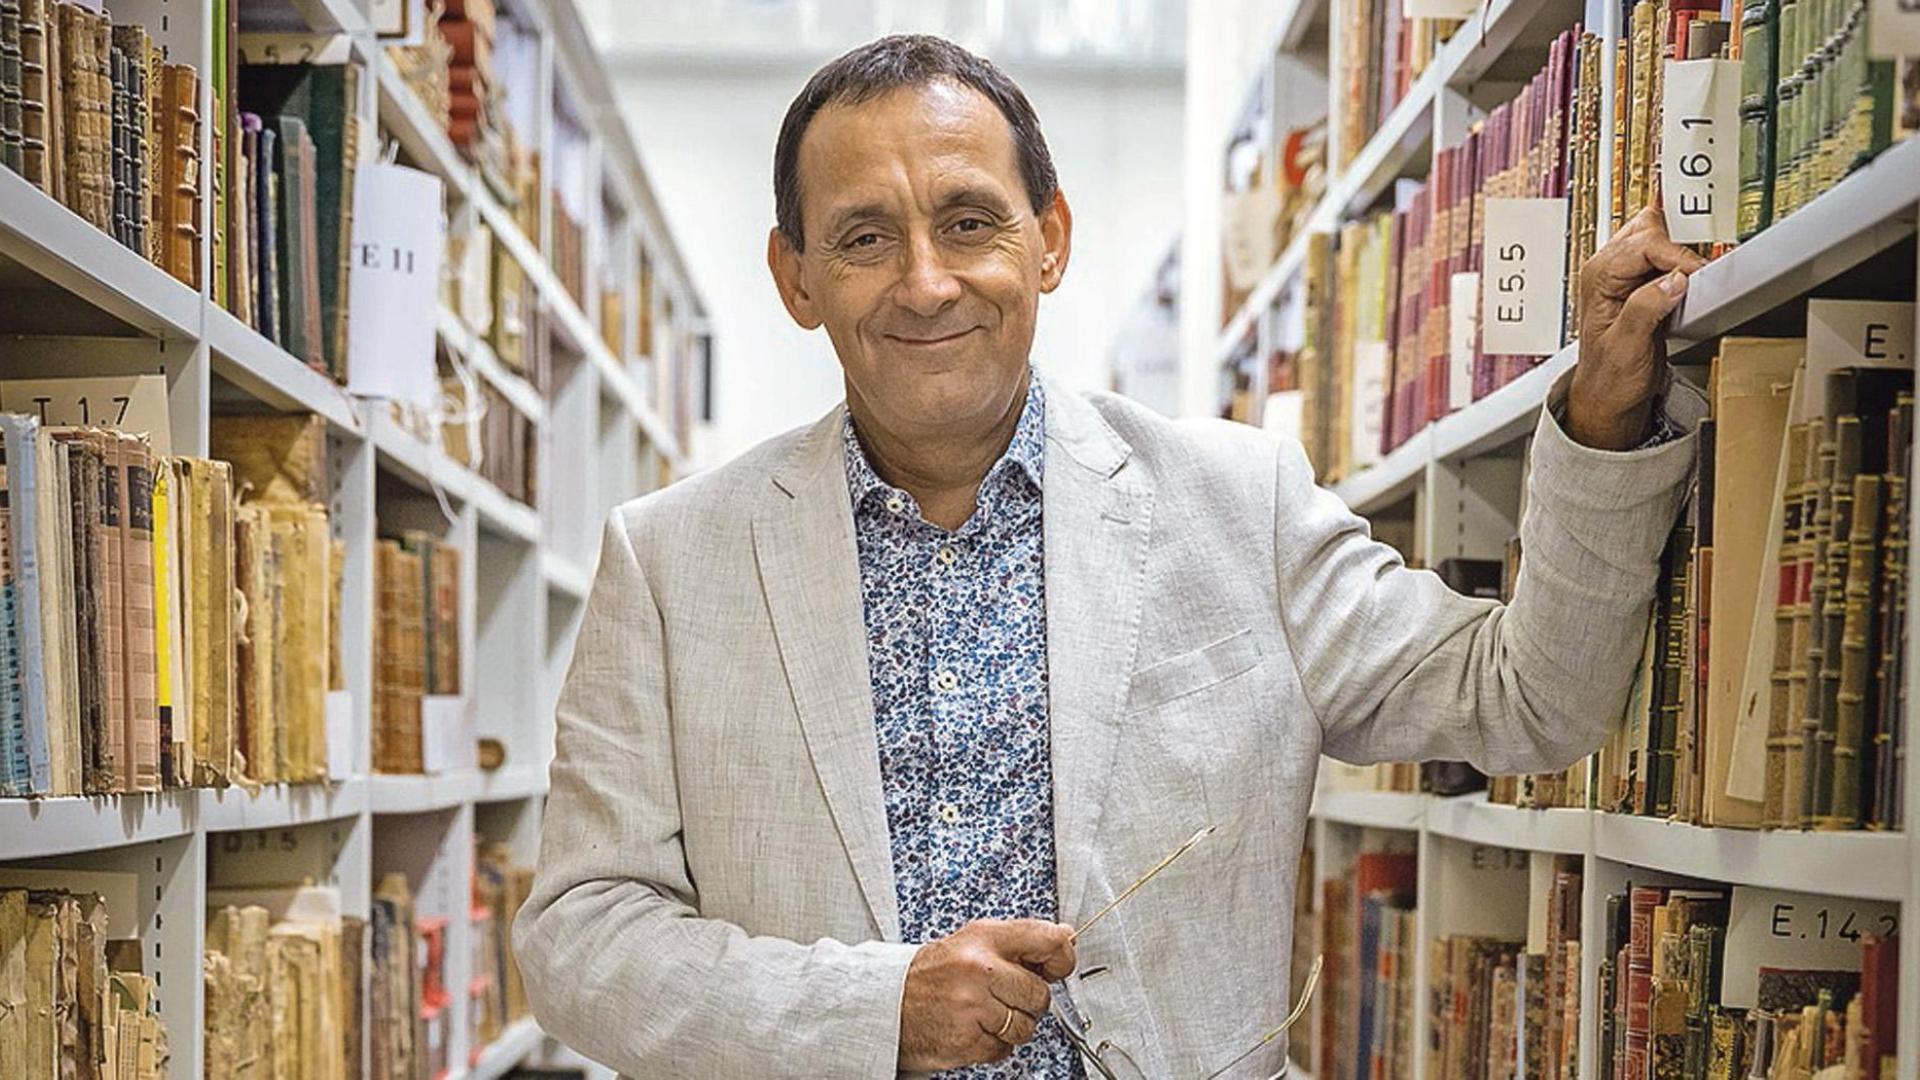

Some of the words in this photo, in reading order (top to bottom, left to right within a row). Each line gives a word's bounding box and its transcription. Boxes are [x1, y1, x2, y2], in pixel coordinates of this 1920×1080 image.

[1680, 118, 1715, 216] E.6.1
[1497, 243, 1526, 322] E.5.5
[32, 396, 130, 426] T.1.7
